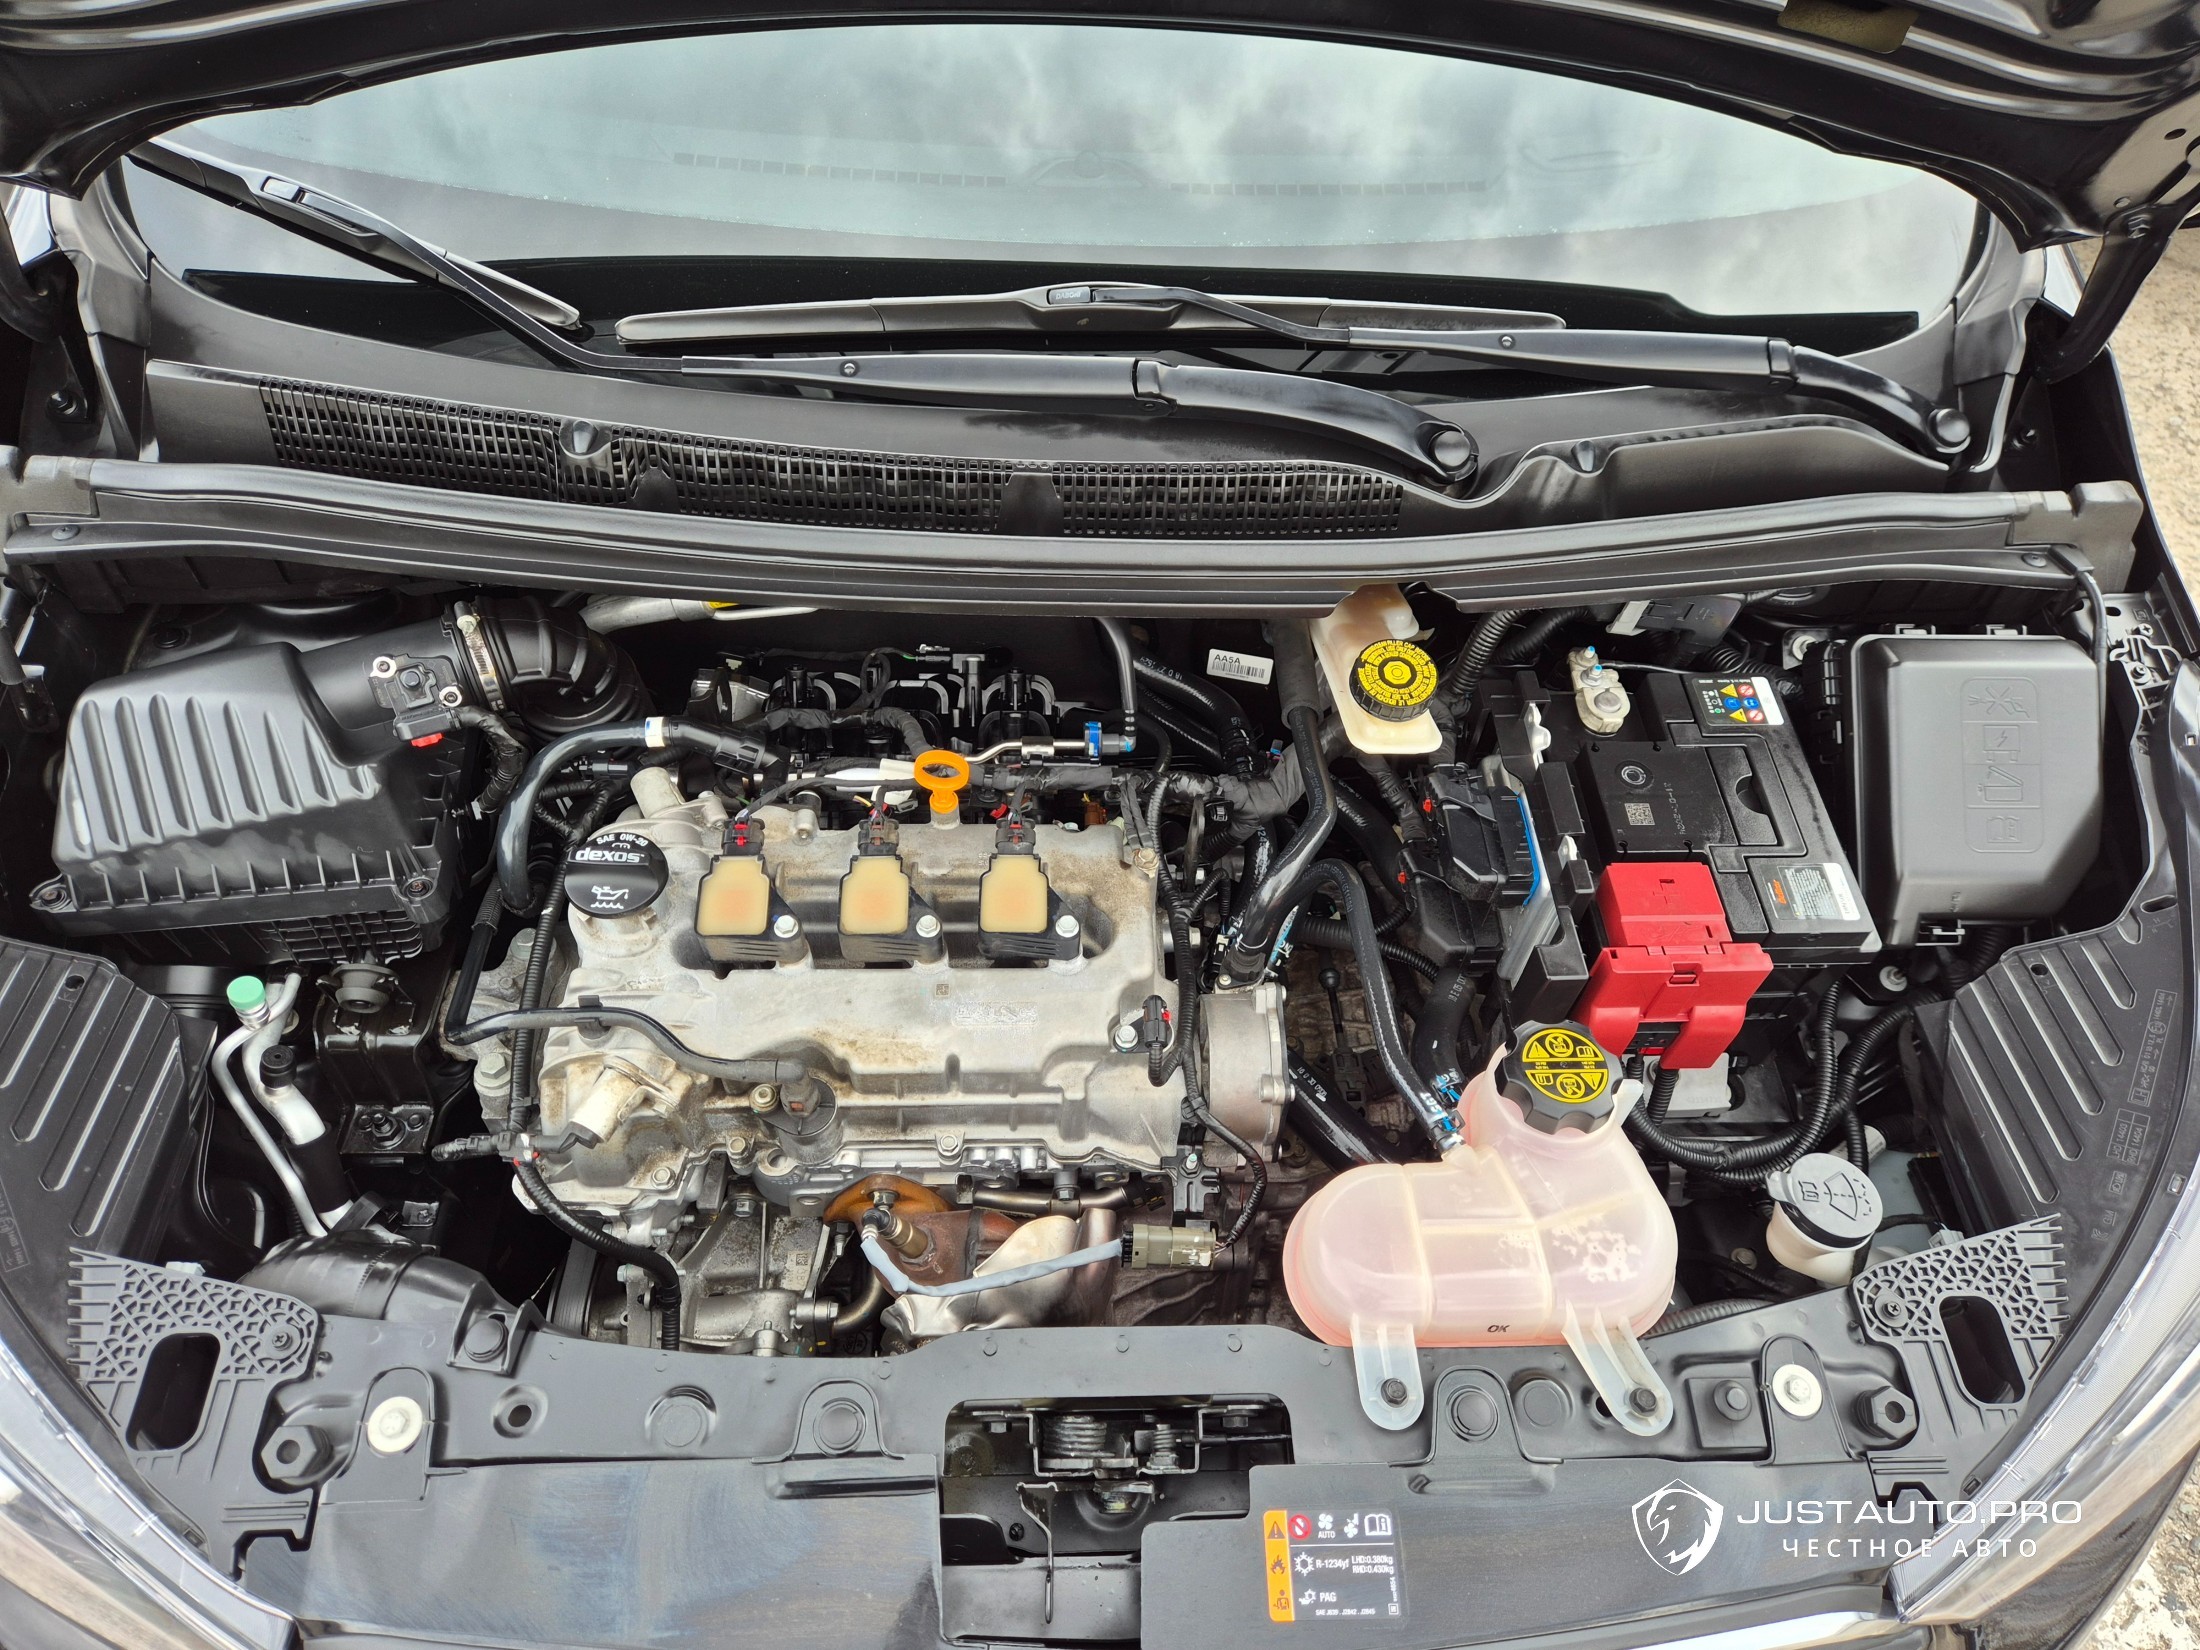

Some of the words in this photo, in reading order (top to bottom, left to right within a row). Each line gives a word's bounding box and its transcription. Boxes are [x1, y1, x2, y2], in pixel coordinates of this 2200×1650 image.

[1214, 654, 1241, 665] AA5A
[596, 833, 615, 845] SAE
[619, 833, 649, 847] 0W-20
[575, 847, 641, 863] dexos
[1487, 1324, 1511, 1333] OK
[1318, 1530, 1335, 1539] AUTO
[1316, 1559, 1349, 1570] R-1234yf
[1320, 1592, 1337, 1602] PAG
